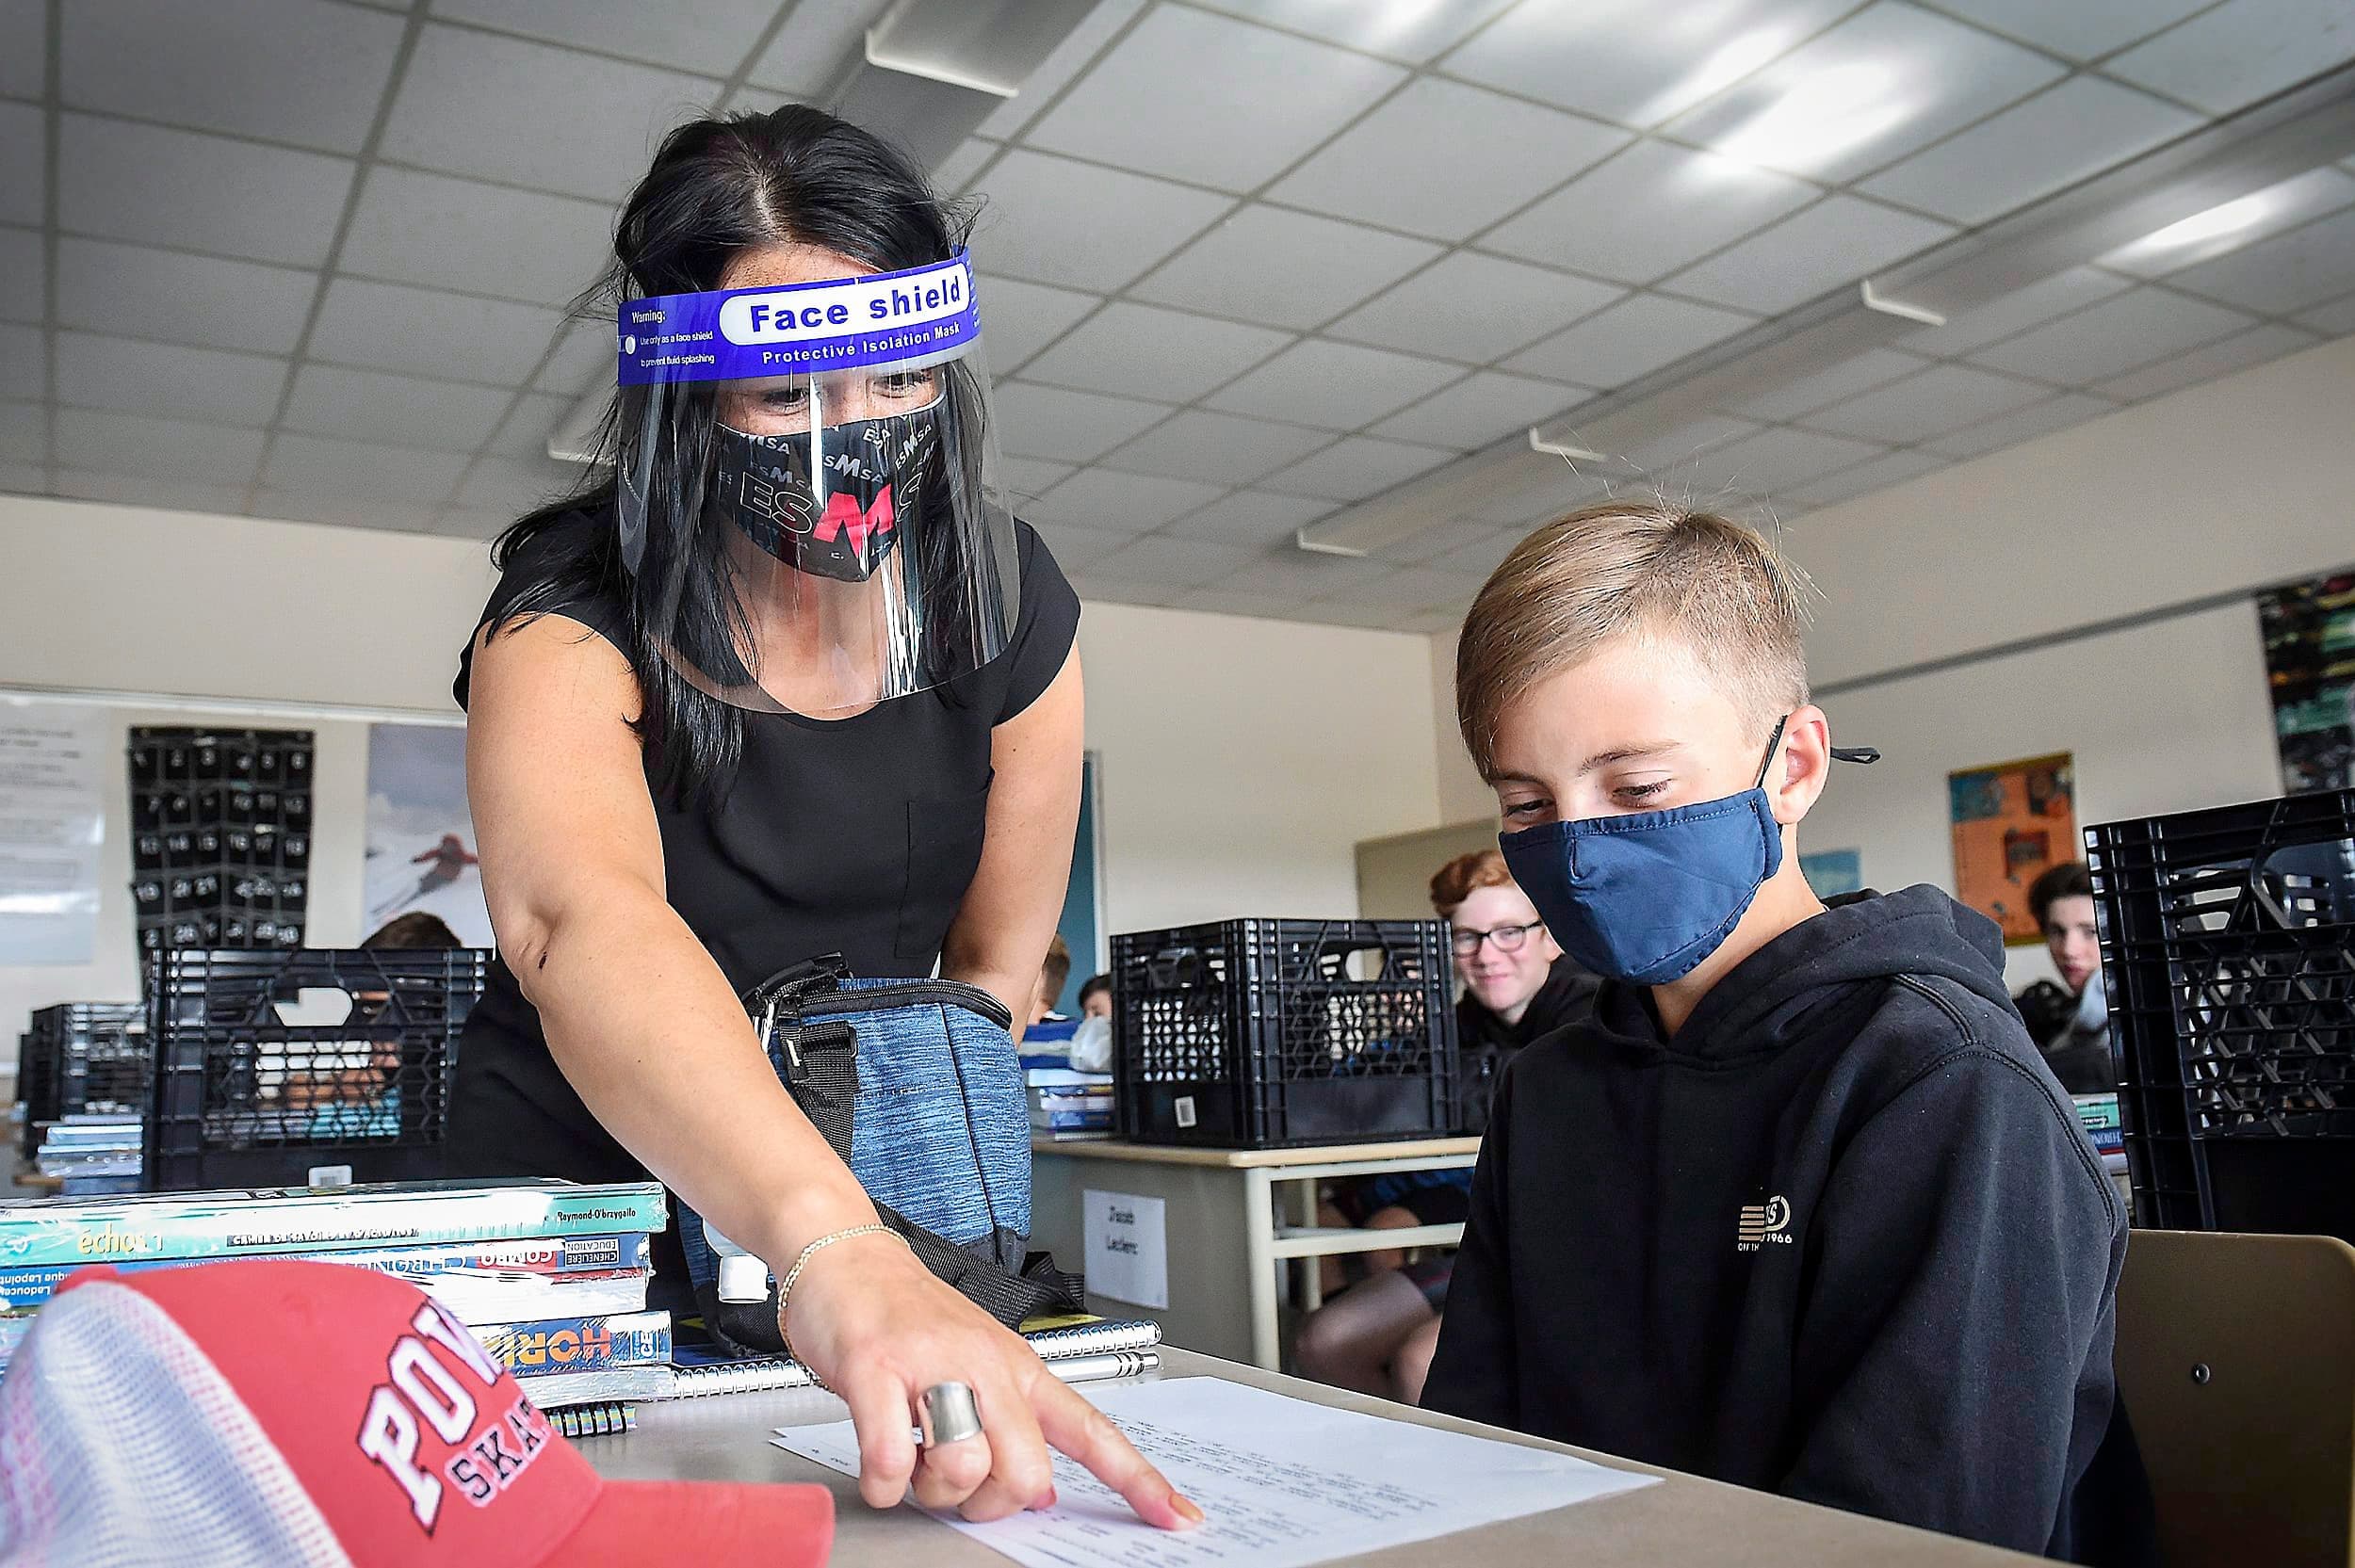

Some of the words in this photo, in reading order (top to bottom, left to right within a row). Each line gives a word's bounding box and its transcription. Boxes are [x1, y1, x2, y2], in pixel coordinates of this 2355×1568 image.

[751, 304, 848, 332] Face
[869, 275, 960, 319] shield
[632, 310, 666, 324] Warning:
[676, 332, 691, 343] face
[691, 331, 713, 341] shield
[762, 342, 855, 364] Protective
[863, 331, 931, 354] Isolation
[934, 321, 960, 339] Mask
[681, 354, 714, 365] splashing
[1767, 1233, 1793, 1243] 1966
